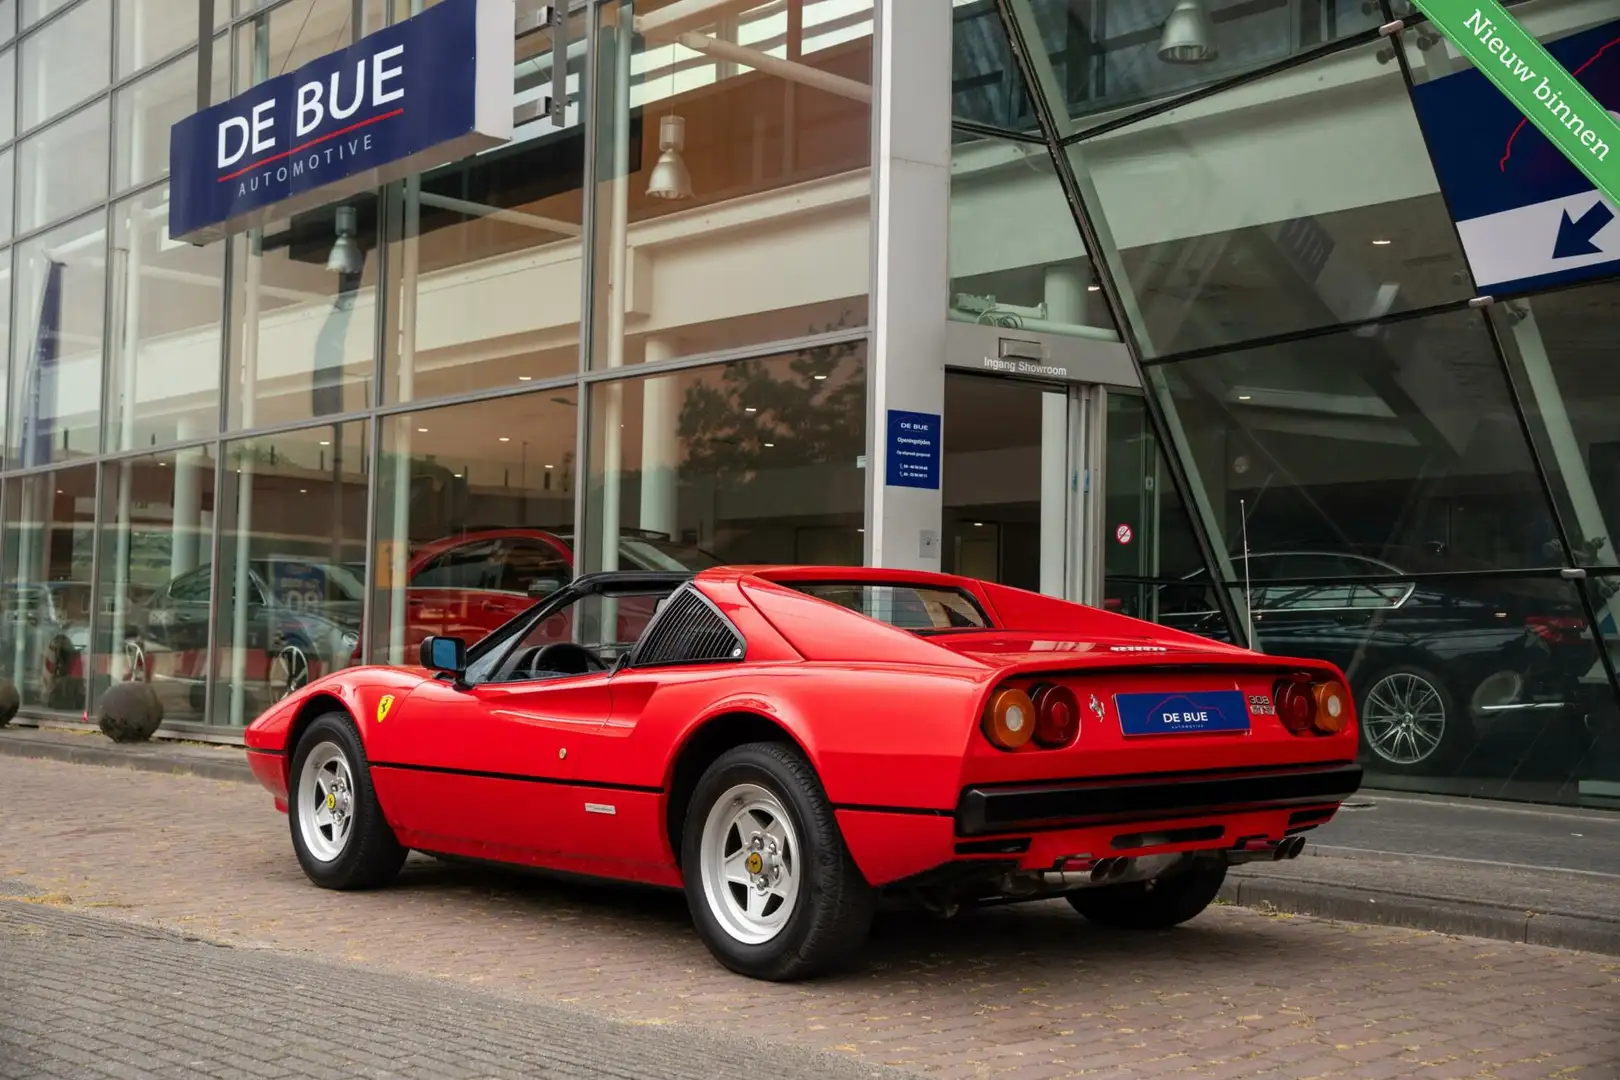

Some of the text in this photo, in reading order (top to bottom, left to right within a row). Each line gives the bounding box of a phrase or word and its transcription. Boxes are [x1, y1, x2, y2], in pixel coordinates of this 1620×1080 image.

[217, 44, 405, 169] DE BUE
[238, 134, 372, 197] AUTOMOTIVE
[984, 356, 1067, 375] Ingang Showroom
[1249, 695, 1270, 704] 308
[1163, 711, 1209, 723] DE BUE
